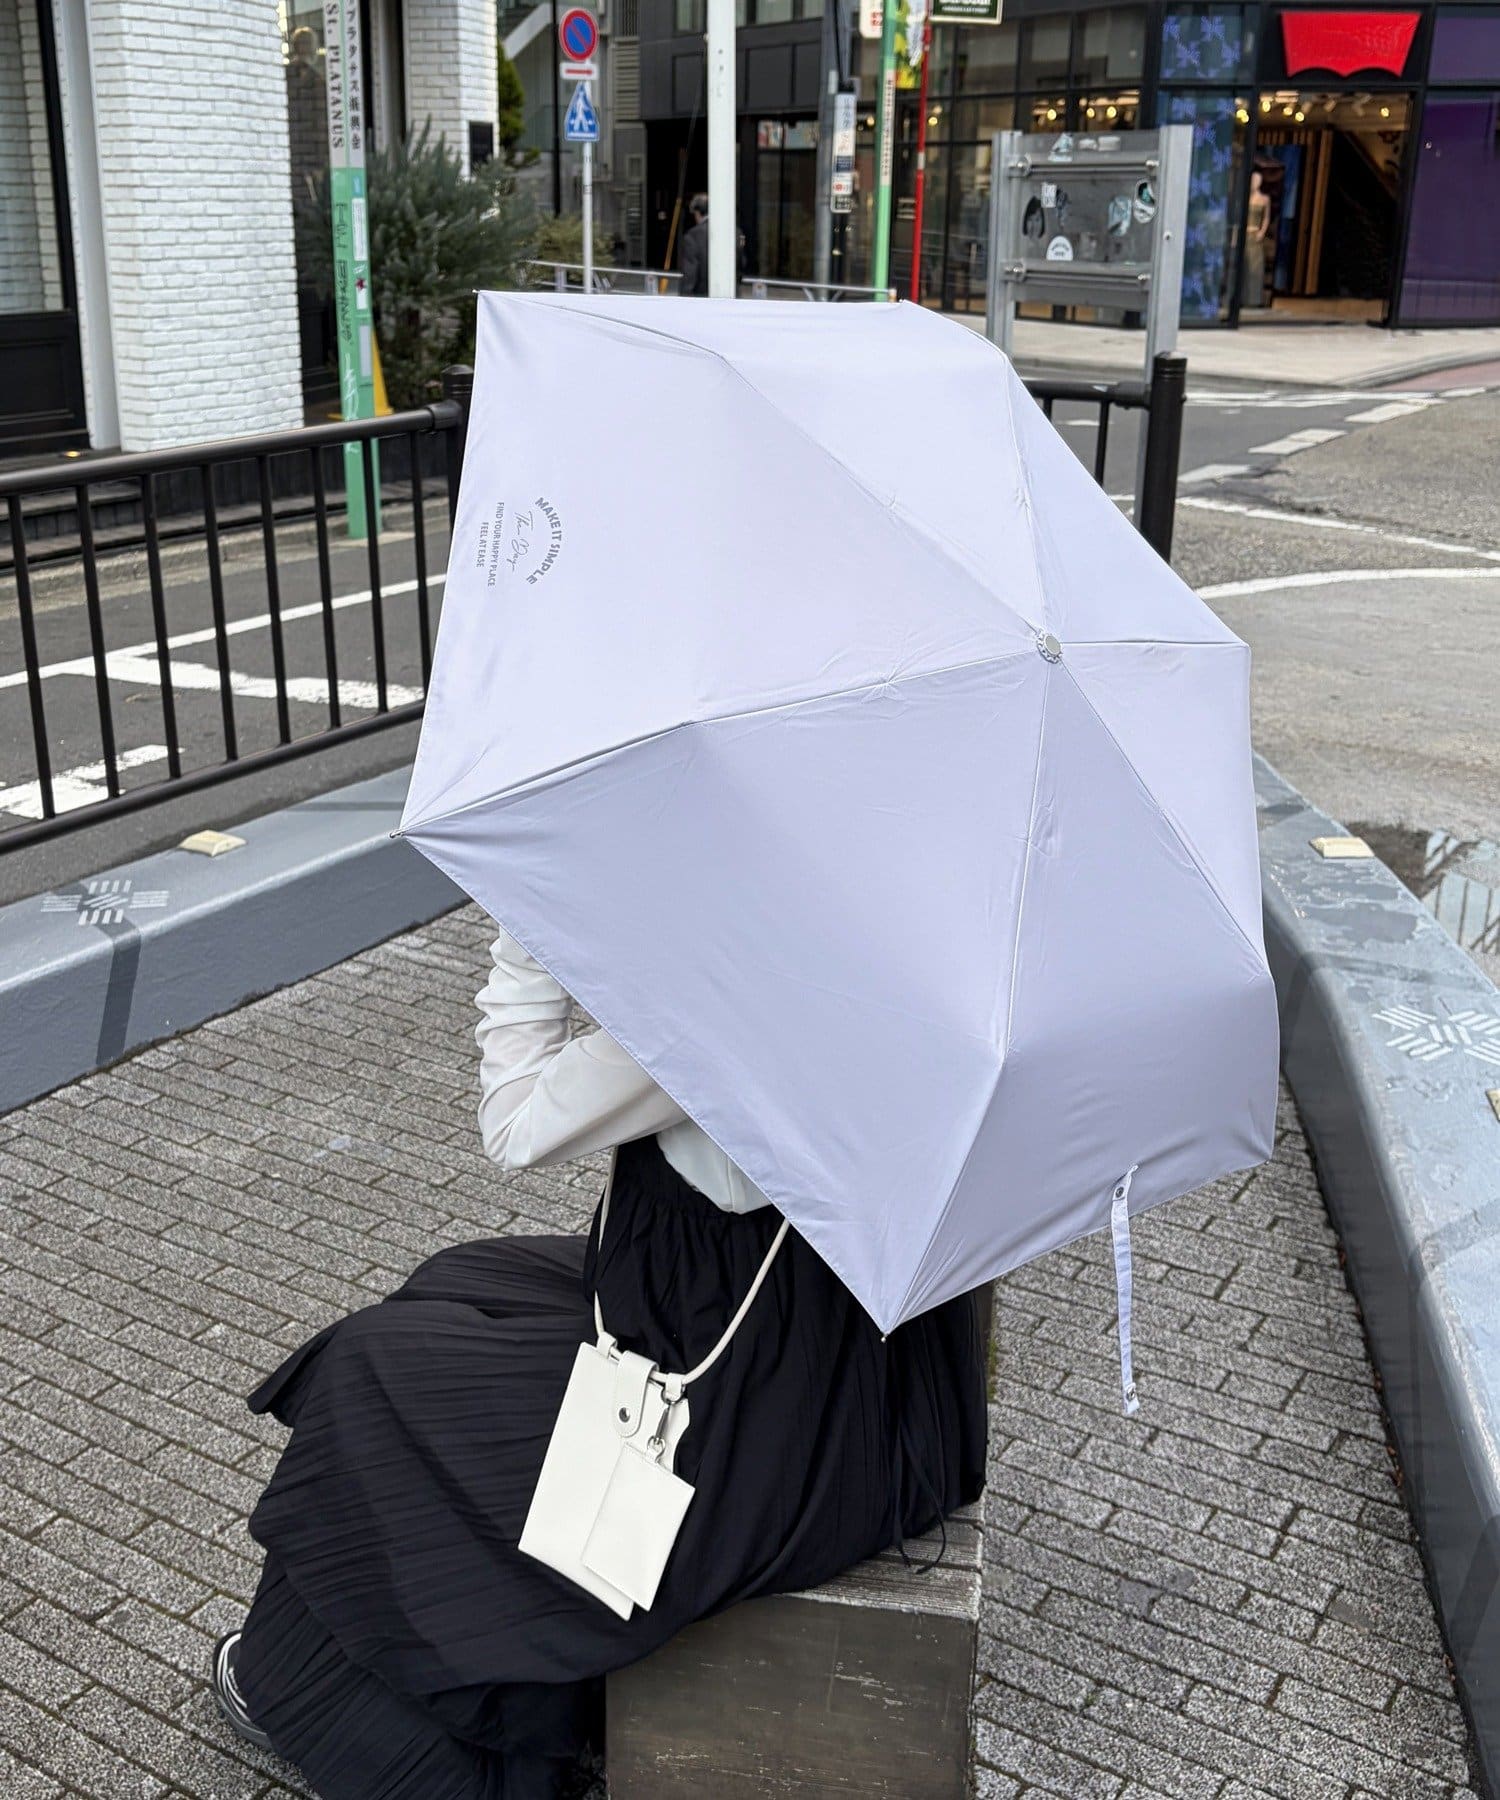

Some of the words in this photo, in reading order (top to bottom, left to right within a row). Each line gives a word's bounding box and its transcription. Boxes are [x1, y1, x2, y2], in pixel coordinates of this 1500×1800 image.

[329, 45, 344, 149] PLATANUS
[496, 502, 504, 519] FIND
[535, 497, 561, 529] MAKE
[480, 522, 489, 538] FEEL
[493, 520, 503, 539] YOUR
[514, 510, 534, 535] The
[478, 539, 487, 548] AT
[551, 530, 562, 542] IT
[476, 550, 486, 568] EASE
[491, 540, 500, 563] HAPPY
[526, 543, 561, 585] SIMPLE
[488, 565, 497, 587] PLACE
